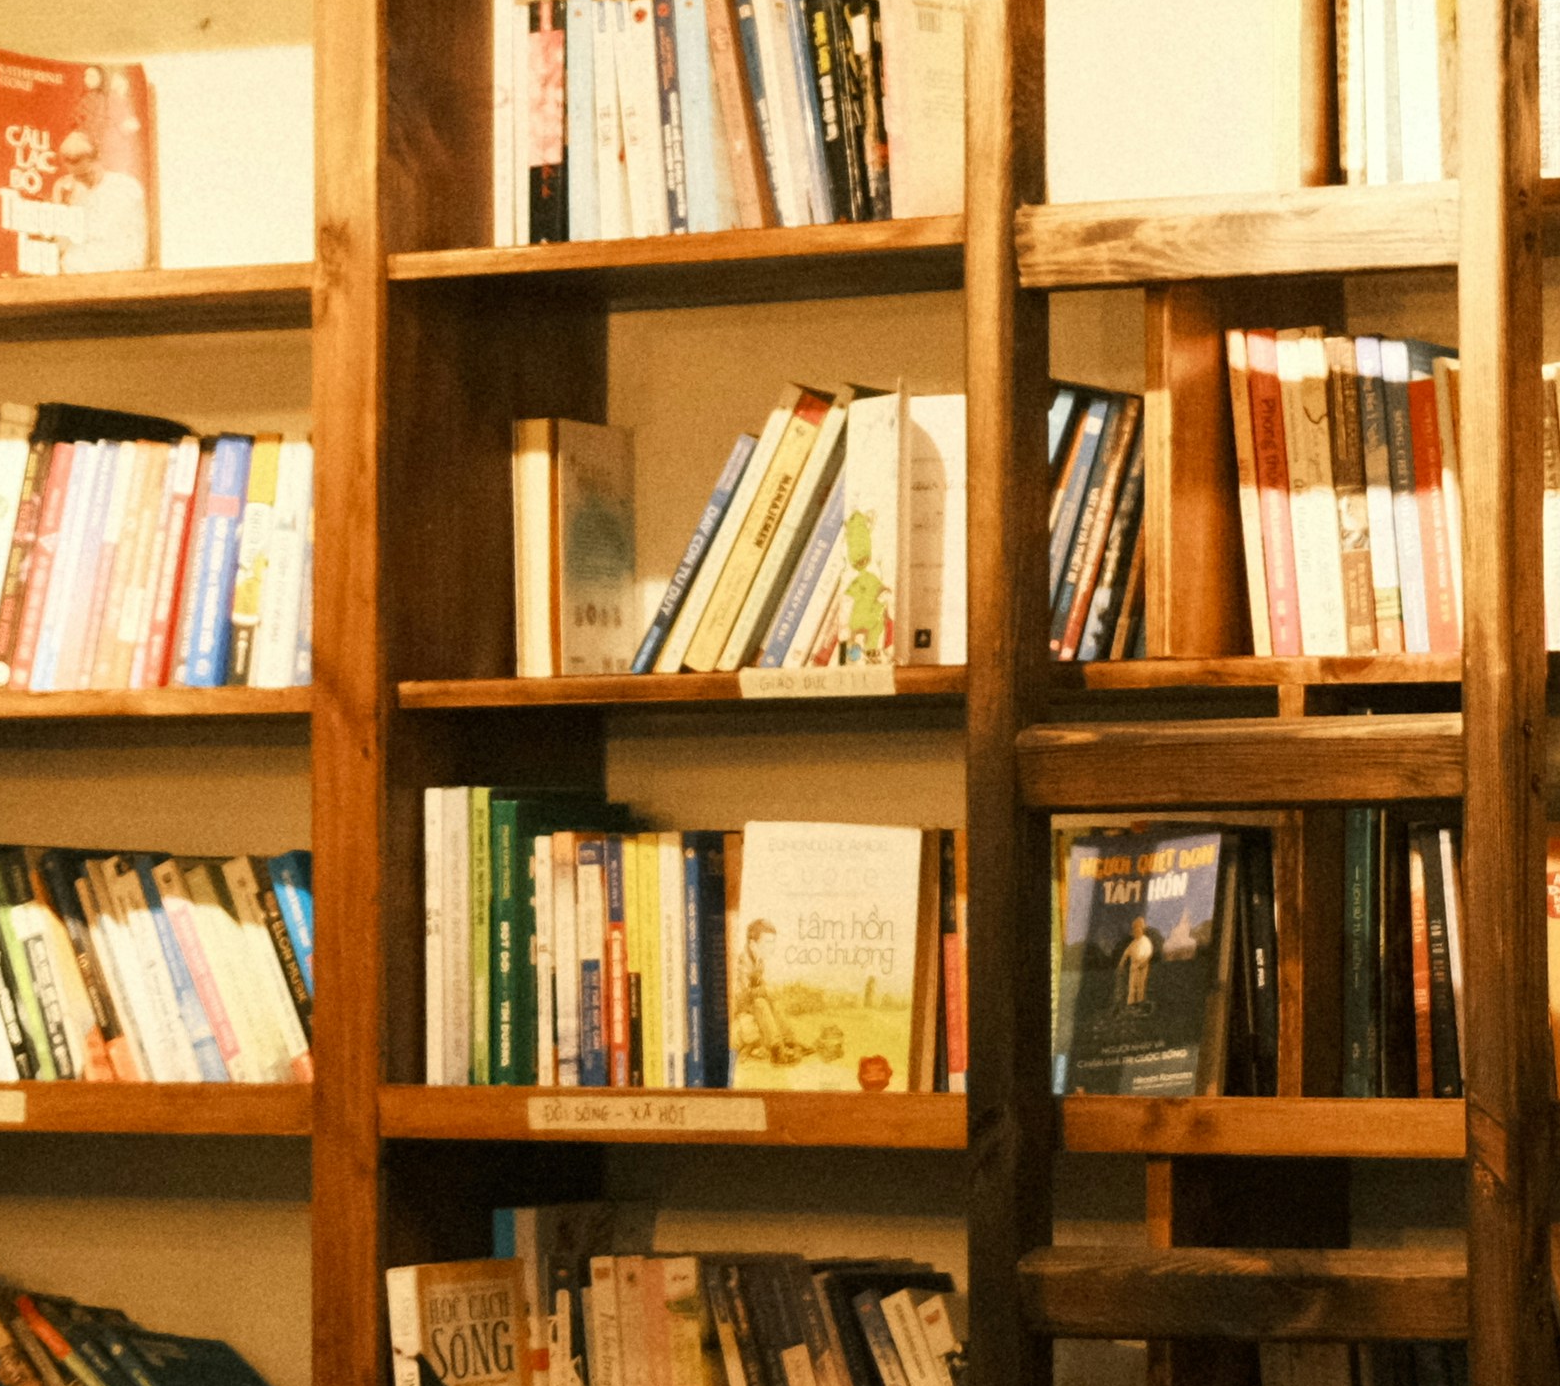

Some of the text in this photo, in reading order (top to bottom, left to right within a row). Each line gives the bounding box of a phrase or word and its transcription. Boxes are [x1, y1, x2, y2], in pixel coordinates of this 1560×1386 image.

[680, 531, 706, 568] CON
[658, 583, 683, 618] DUY
[797, 902, 895, 942] tâm hồn
[267, 917, 311, 1004] ELON MUSK
[784, 942, 895, 976] cao thượng
